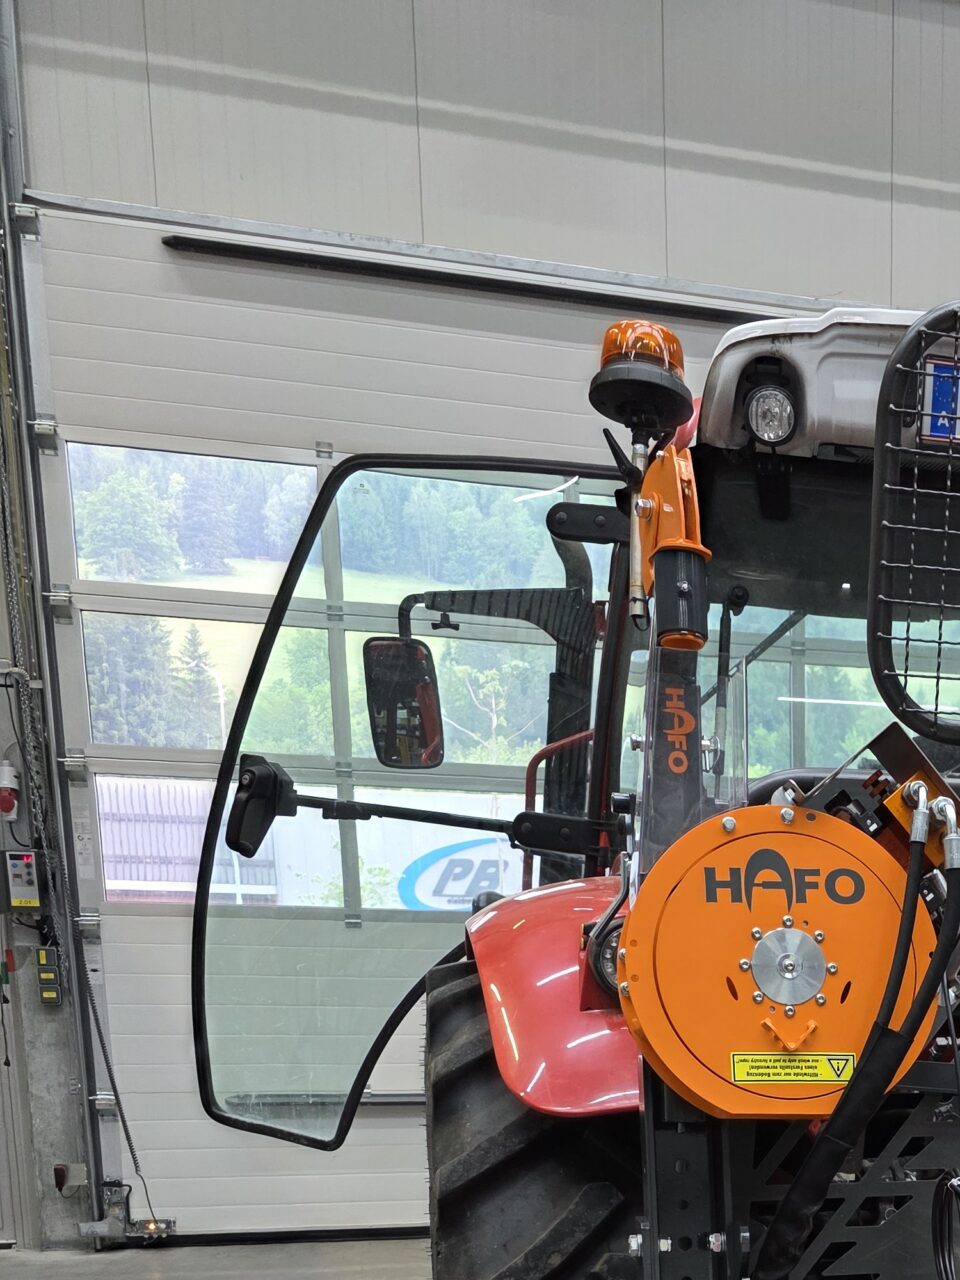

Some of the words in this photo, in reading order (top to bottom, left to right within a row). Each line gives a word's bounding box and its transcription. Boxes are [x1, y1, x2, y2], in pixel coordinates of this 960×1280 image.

[937, 411, 949, 427] A
[662, 687, 696, 774] HAFO
[704, 848, 865, 914] HAFO
